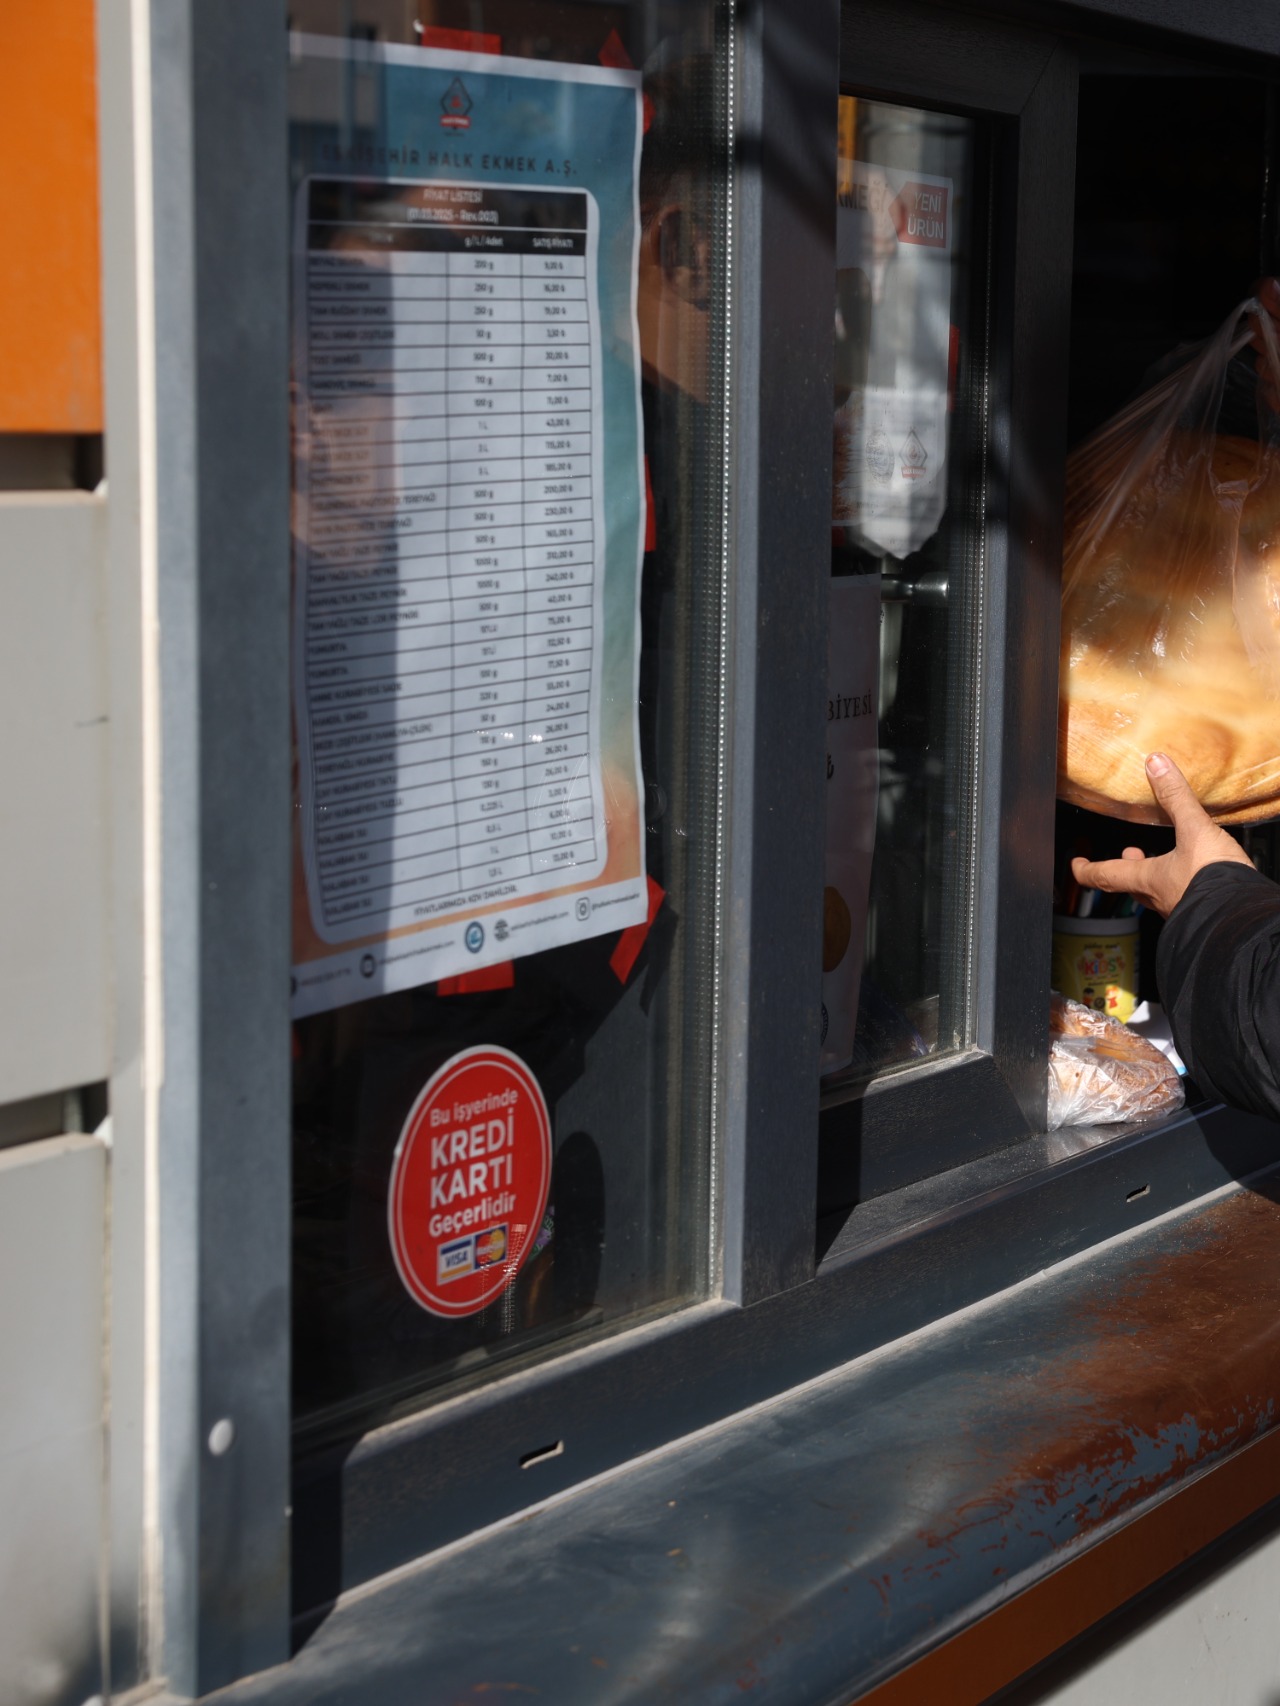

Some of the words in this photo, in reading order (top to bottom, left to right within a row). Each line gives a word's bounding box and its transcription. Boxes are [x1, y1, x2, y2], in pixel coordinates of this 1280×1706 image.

[429, 151, 473, 168] HALK
[482, 154, 536, 173] EKMEK
[545, 156, 578, 176] A.Ş.
[914, 191, 943, 214] YENİ
[907, 214, 944, 240] ÜRÜN
[430, 1108, 450, 1127] Bu
[453, 1087, 518, 1123] işyerinde
[431, 1109, 514, 1169] KREDİ
[429, 1153, 512, 1209] KARTI
[429, 1194, 516, 1237] Geçerlidir
[445, 1250, 468, 1268] VISA
